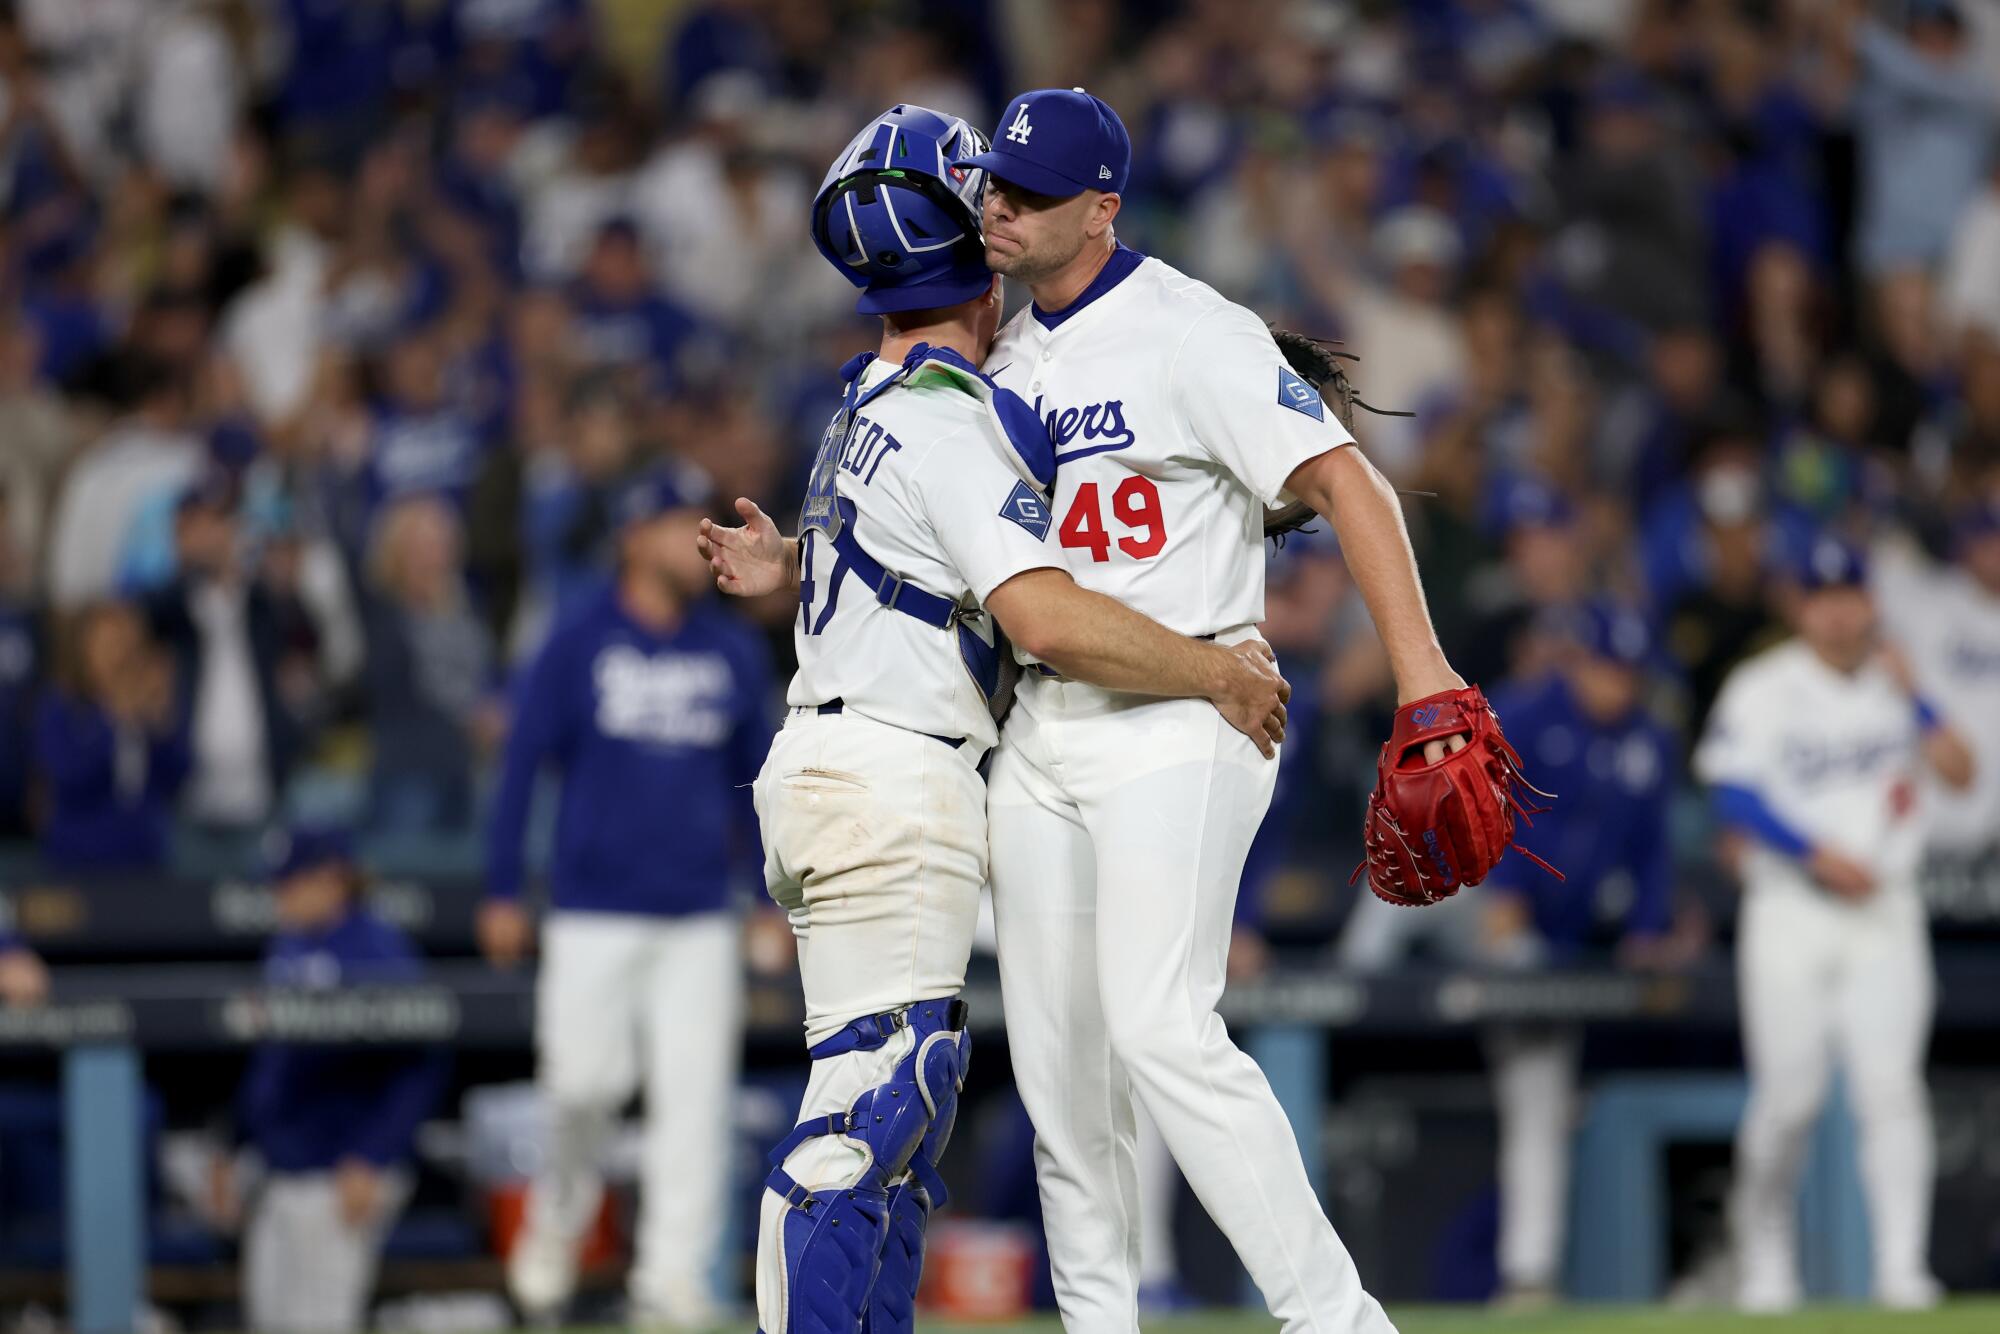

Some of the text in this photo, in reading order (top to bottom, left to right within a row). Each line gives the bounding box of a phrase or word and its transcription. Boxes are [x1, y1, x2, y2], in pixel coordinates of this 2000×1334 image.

[1006, 103, 1032, 144] LA
[1016, 498, 1040, 518] G
[1058, 474, 1168, 563] 49
